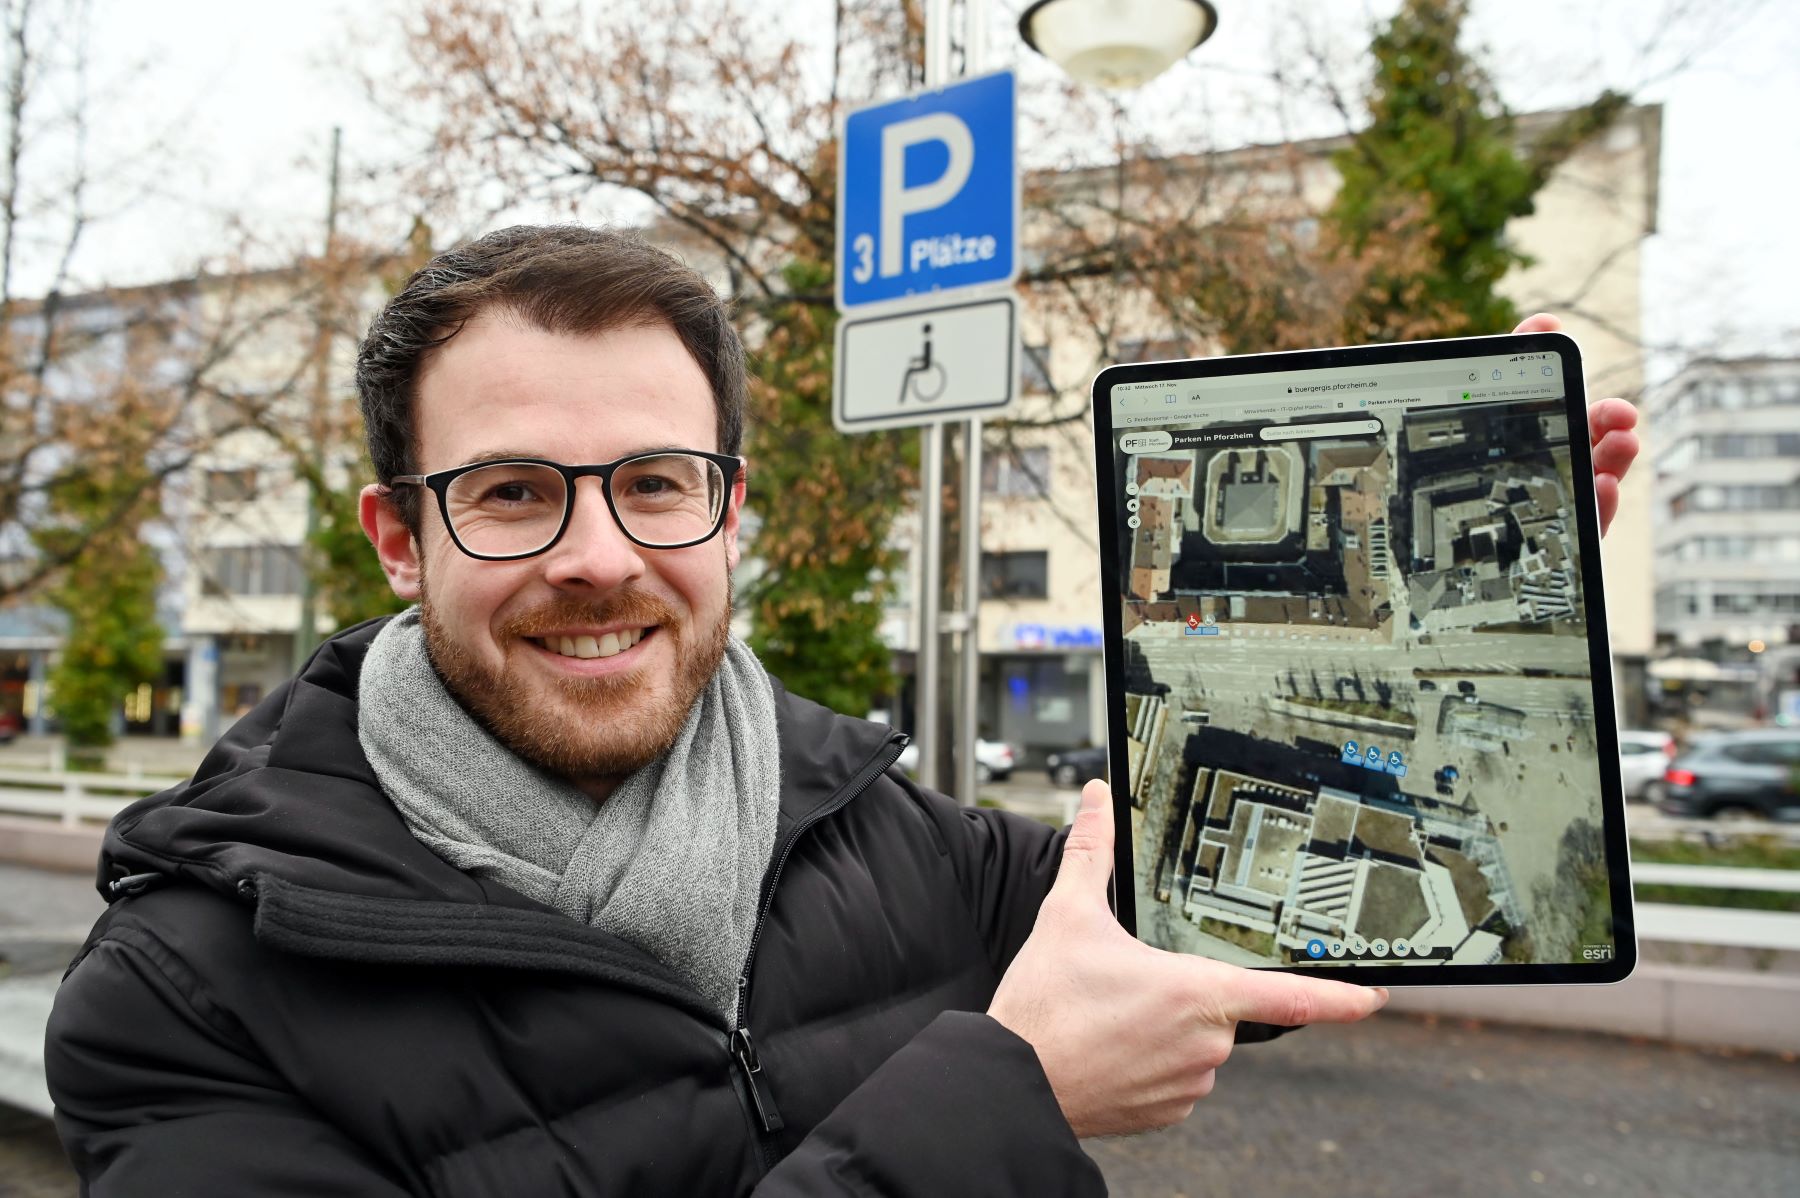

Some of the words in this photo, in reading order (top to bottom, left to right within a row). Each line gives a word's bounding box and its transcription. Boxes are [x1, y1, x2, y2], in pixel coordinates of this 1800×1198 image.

[879, 112, 975, 279] P
[852, 232, 875, 285] 3
[910, 233, 997, 273] Plätze
[1294, 380, 1378, 394] buergergis.pforzheim.de
[1213, 432, 1254, 440] Pforzheim
[1125, 439, 1138, 448] PF
[1583, 945, 1612, 960] esri
